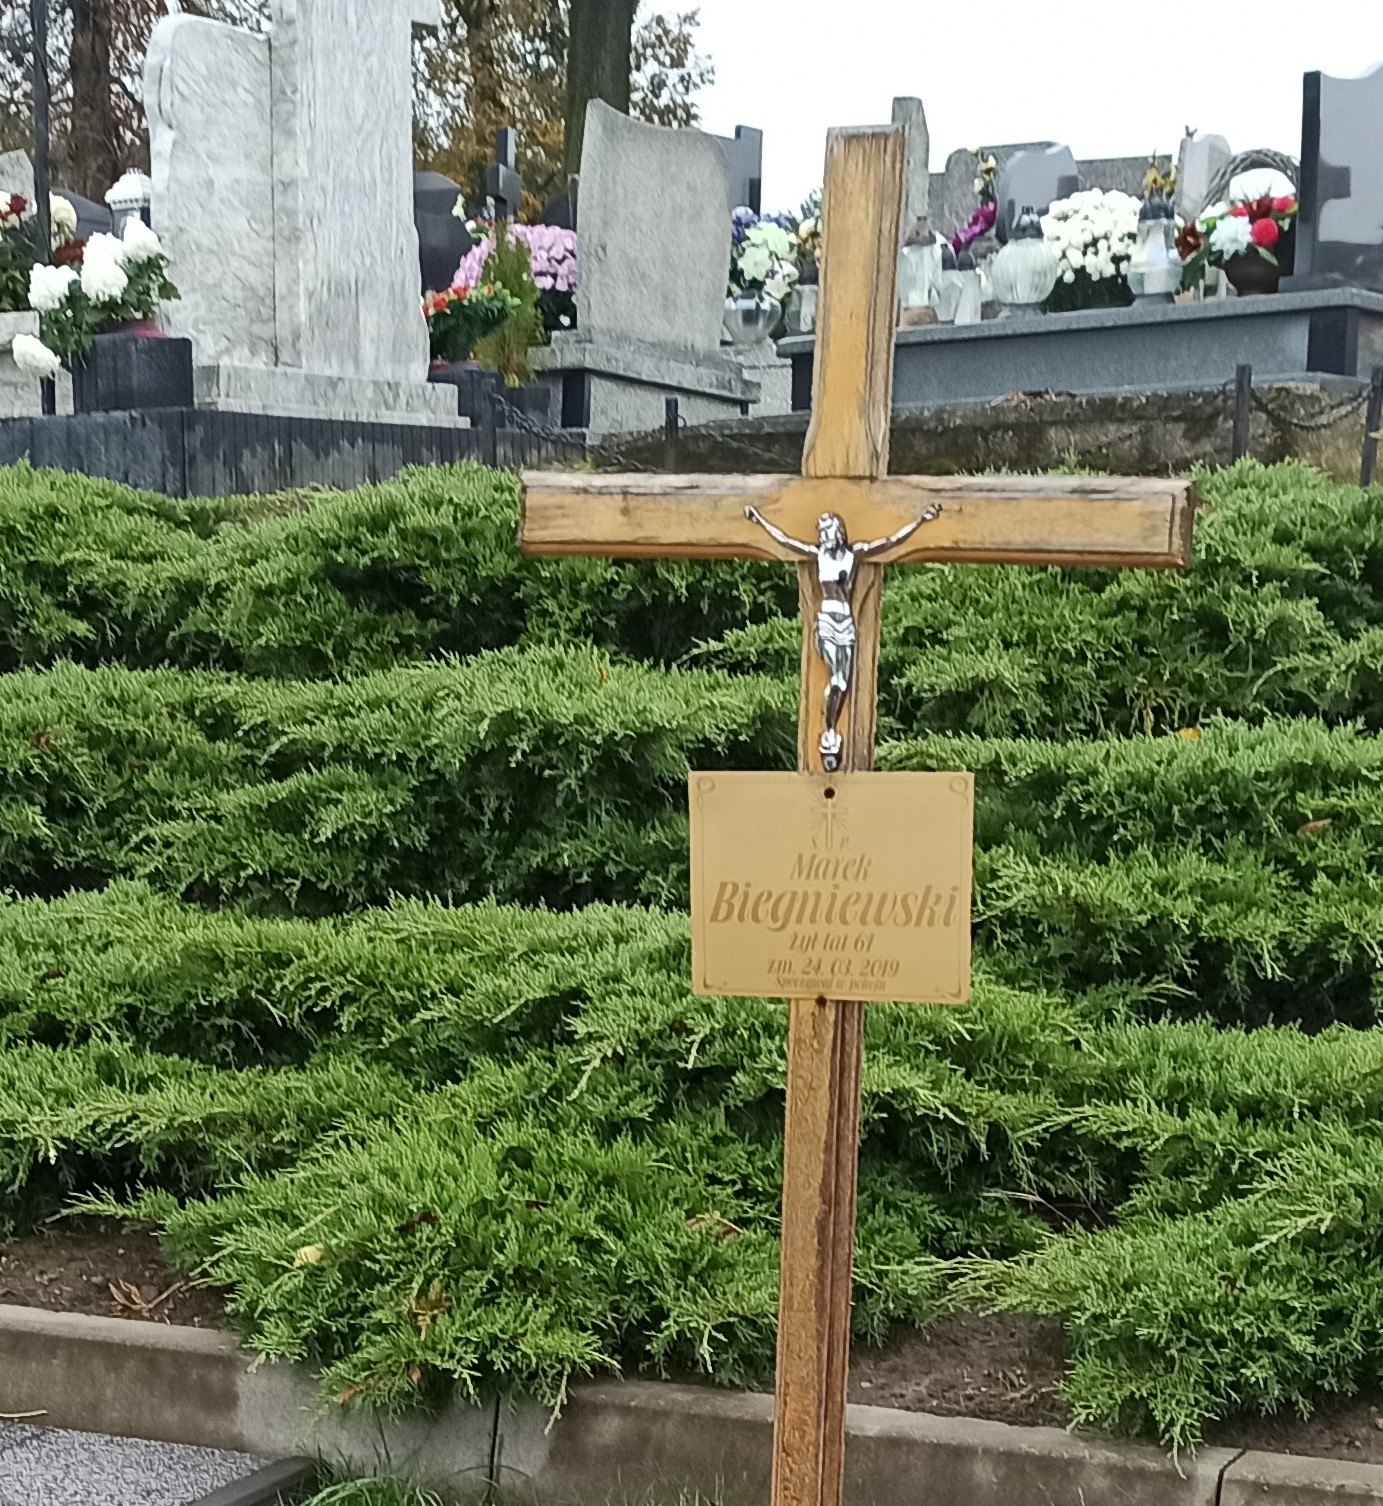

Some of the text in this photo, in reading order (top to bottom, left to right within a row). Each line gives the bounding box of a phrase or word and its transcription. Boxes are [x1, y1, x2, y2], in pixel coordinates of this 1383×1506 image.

[790, 852, 873, 881] Marek
[710, 880, 961, 933] Biegniewski
[823, 931, 849, 952] lat
[853, 931, 875, 953] 61
[859, 957, 901, 979] 2019
